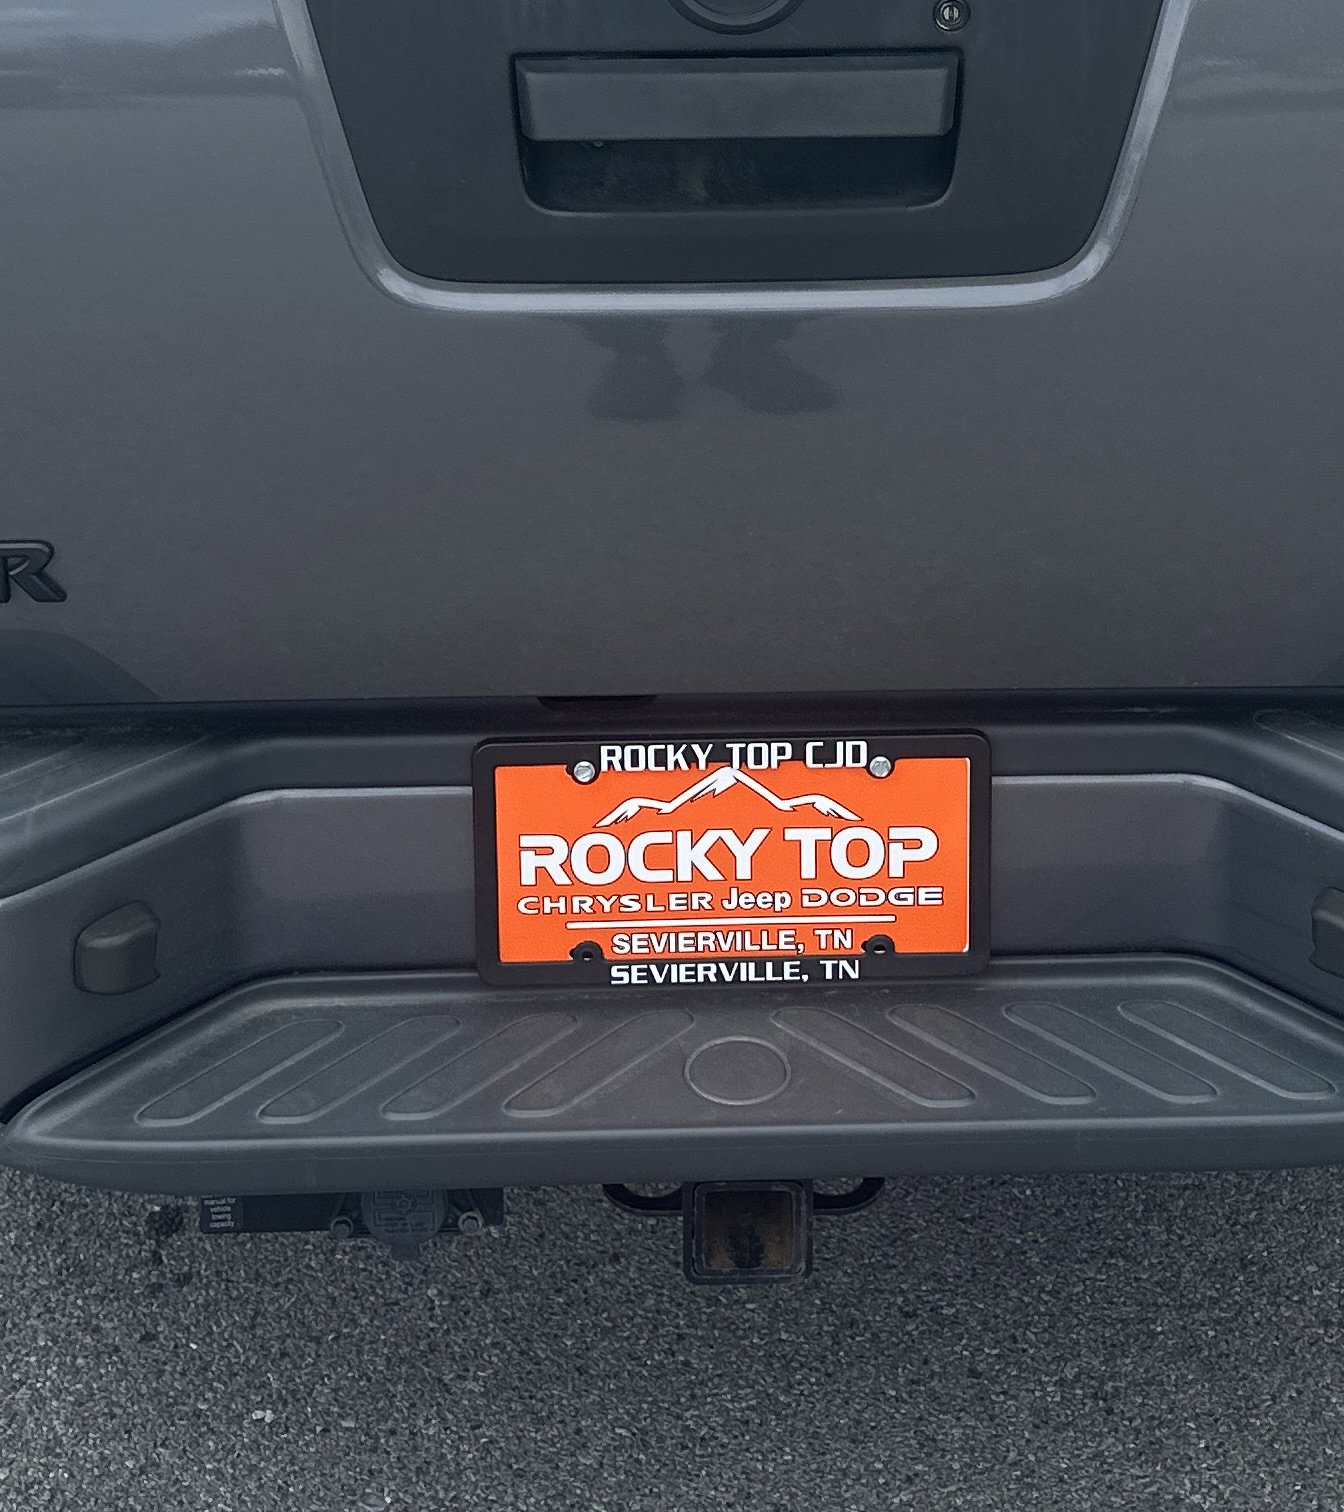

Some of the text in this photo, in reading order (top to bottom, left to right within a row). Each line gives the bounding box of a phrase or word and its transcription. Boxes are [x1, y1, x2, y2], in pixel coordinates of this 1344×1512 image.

[599, 740, 868, 772] ROCKY TOP CJD
[518, 825, 940, 886] ROCKY TOP
[517, 886, 944, 915] CHRYSLER Jeep DODGE
[611, 928, 853, 956] SEVIERVILLE, TN
[610, 959, 860, 985] SEVIERVILLE, TN
